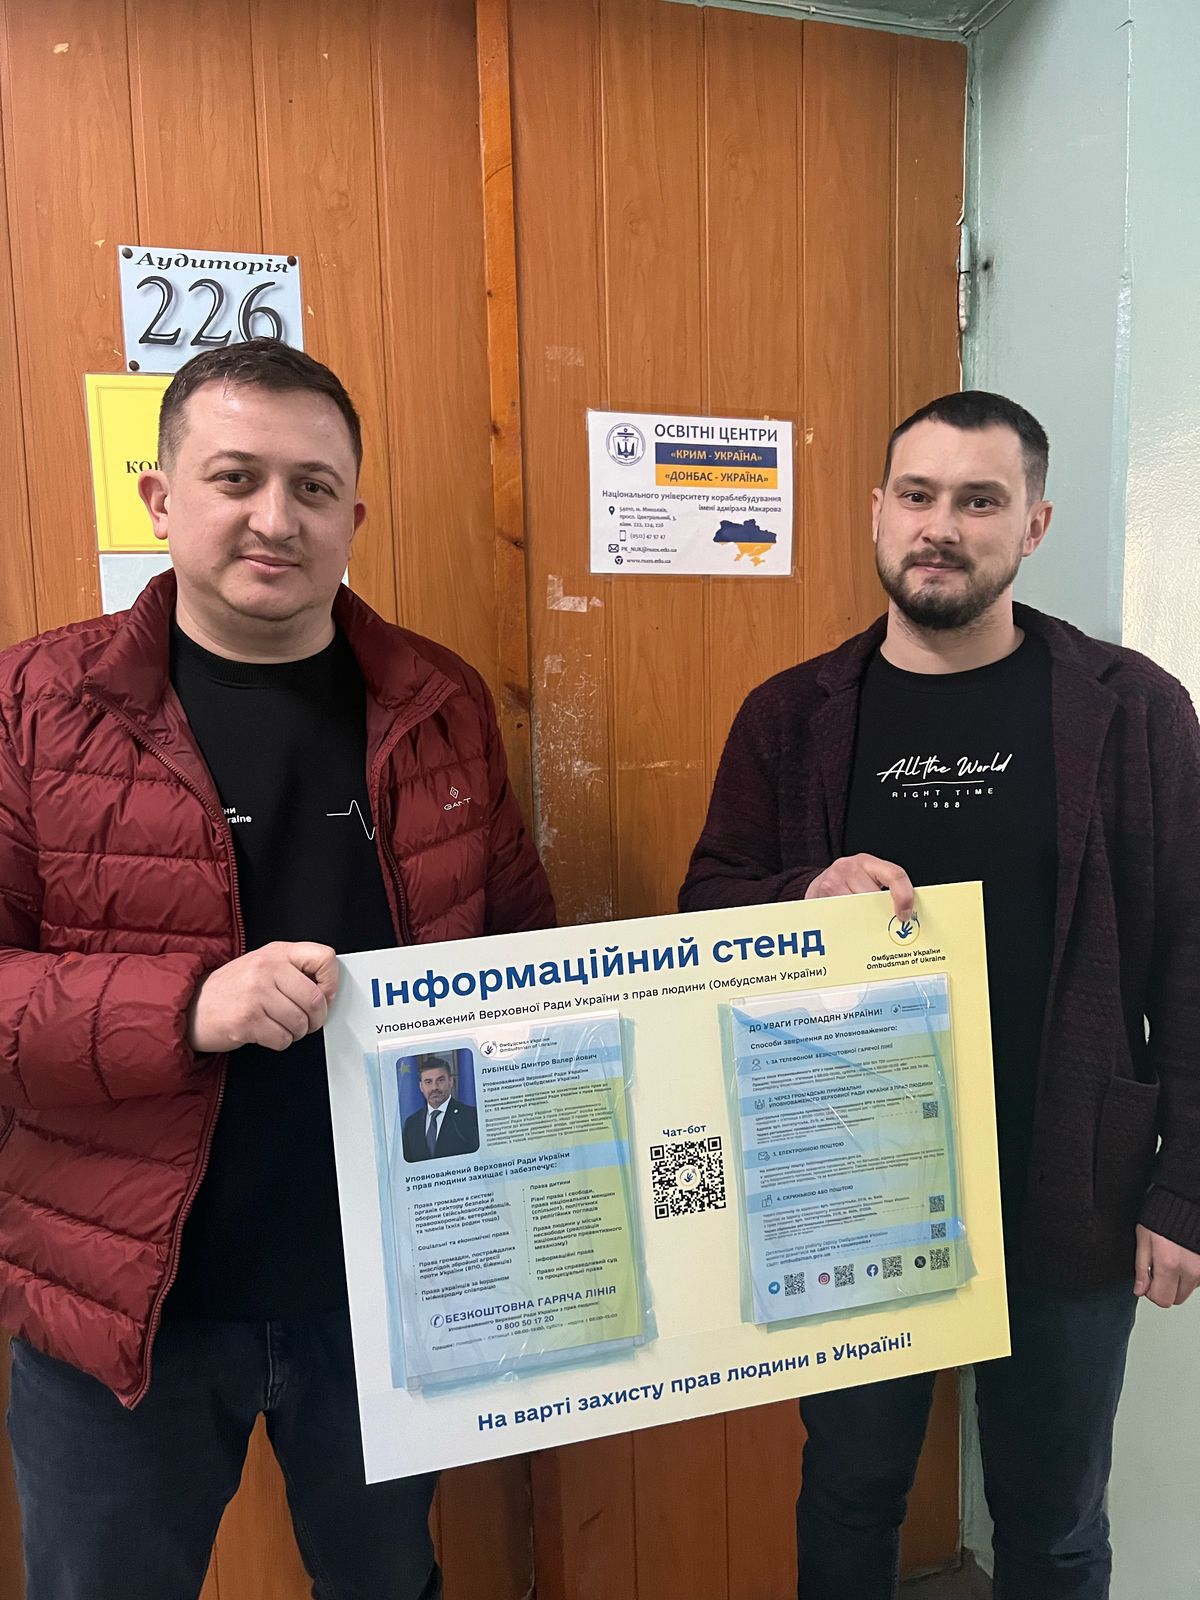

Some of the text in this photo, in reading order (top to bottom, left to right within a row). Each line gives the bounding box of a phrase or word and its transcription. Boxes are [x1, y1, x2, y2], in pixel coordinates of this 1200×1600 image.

[134, 251, 289, 275] Аудиторія
[136, 275, 285, 346] 226
[654, 423, 777, 442] ОСВІТНІ ЦЕНТРИ
[670, 449, 706, 459] «КРИМ
[714, 450, 762, 461] УКРАЇНА»
[664, 470, 712, 482] «ДОНБАС
[720, 471, 768, 482] УКРАЇНА»
[602, 489, 781, 503] Національного університету кораблебудування
[716, 504, 746, 513] адмірала
[747, 505, 781, 514] Макарова
[956, 751, 1013, 777] World
[891, 787, 994, 798] RIGHT TIME
[923, 801, 960, 809] 1988
[866, 959, 909, 970] Ombudsman
[919, 955, 946, 963] Ukraine
[871, 948, 940, 961] Омбудсман України
[371, 929, 825, 1008] Інформаційний стенд
[375, 966, 826, 1034] Уповноважений Верховної Ради України з прав людини (Омбудсман України)
[749, 1008, 882, 1032] ДО УВАГИ ГРОМАДЯН УКРАЇНИ!
[750, 1039, 781, 1049] Способи
[783, 1035, 822, 1045] звернення
[834, 1025, 897, 1038] Уповноваженого:
[481, 1054, 597, 1074] ЛУБІНЕЦЬ Дмитро Валерйович
[662, 1124, 706, 1137] Чат-бот
[404, 1152, 569, 1183] Уповноважений Верховної Ради України
[412, 1182, 432, 1191] прав
[433, 1176, 466, 1187] людини
[468, 1170, 503, 1181] захищає
[509, 1162, 557, 1174] забезпечує:
[414, 1207, 437, 1215] органів
[438, 1203, 463, 1211] сектору
[464, 1199, 489, 1207] безпеки
[433, 1197, 464, 1206] громадян
[469, 1191, 494, 1200] системі
[414, 1202, 510, 1221] оборони (військовослужбовців,
[415, 1210, 496, 1228] правоохоронців, ветеранів
[461, 1219, 480, 1227] родин
[417, 1241, 447, 1251] Соціальні
[456, 1233, 490, 1244] економічні
[419, 1254, 500, 1273] внаслідок збройної агресії
[438, 1254, 470, 1264] громадян,
[471, 1246, 515, 1257] постраждалих
[439, 1267, 463, 1276] України
[464, 1263, 482, 1271] (ВПО,
[482, 1258, 512, 1268] біженців)
[425, 1290, 463, 1300] міжнародну
[463, 1284, 496, 1293] співпрацю
[441, 1282, 470, 1293] українців
[479, 1275, 509, 1284] кордоном
[445, 1285, 616, 1323] БЕЗКОШТОВНА ГАРЯЧА ЛІНІЯ
[504, 1320, 520, 1329] 800
[521, 1318, 532, 1326] 50
[534, 1316, 542, 1324] 17
[543, 1314, 554, 1323] 20
[478, 1332, 911, 1431] На варті захисту прав людини в Україні!
